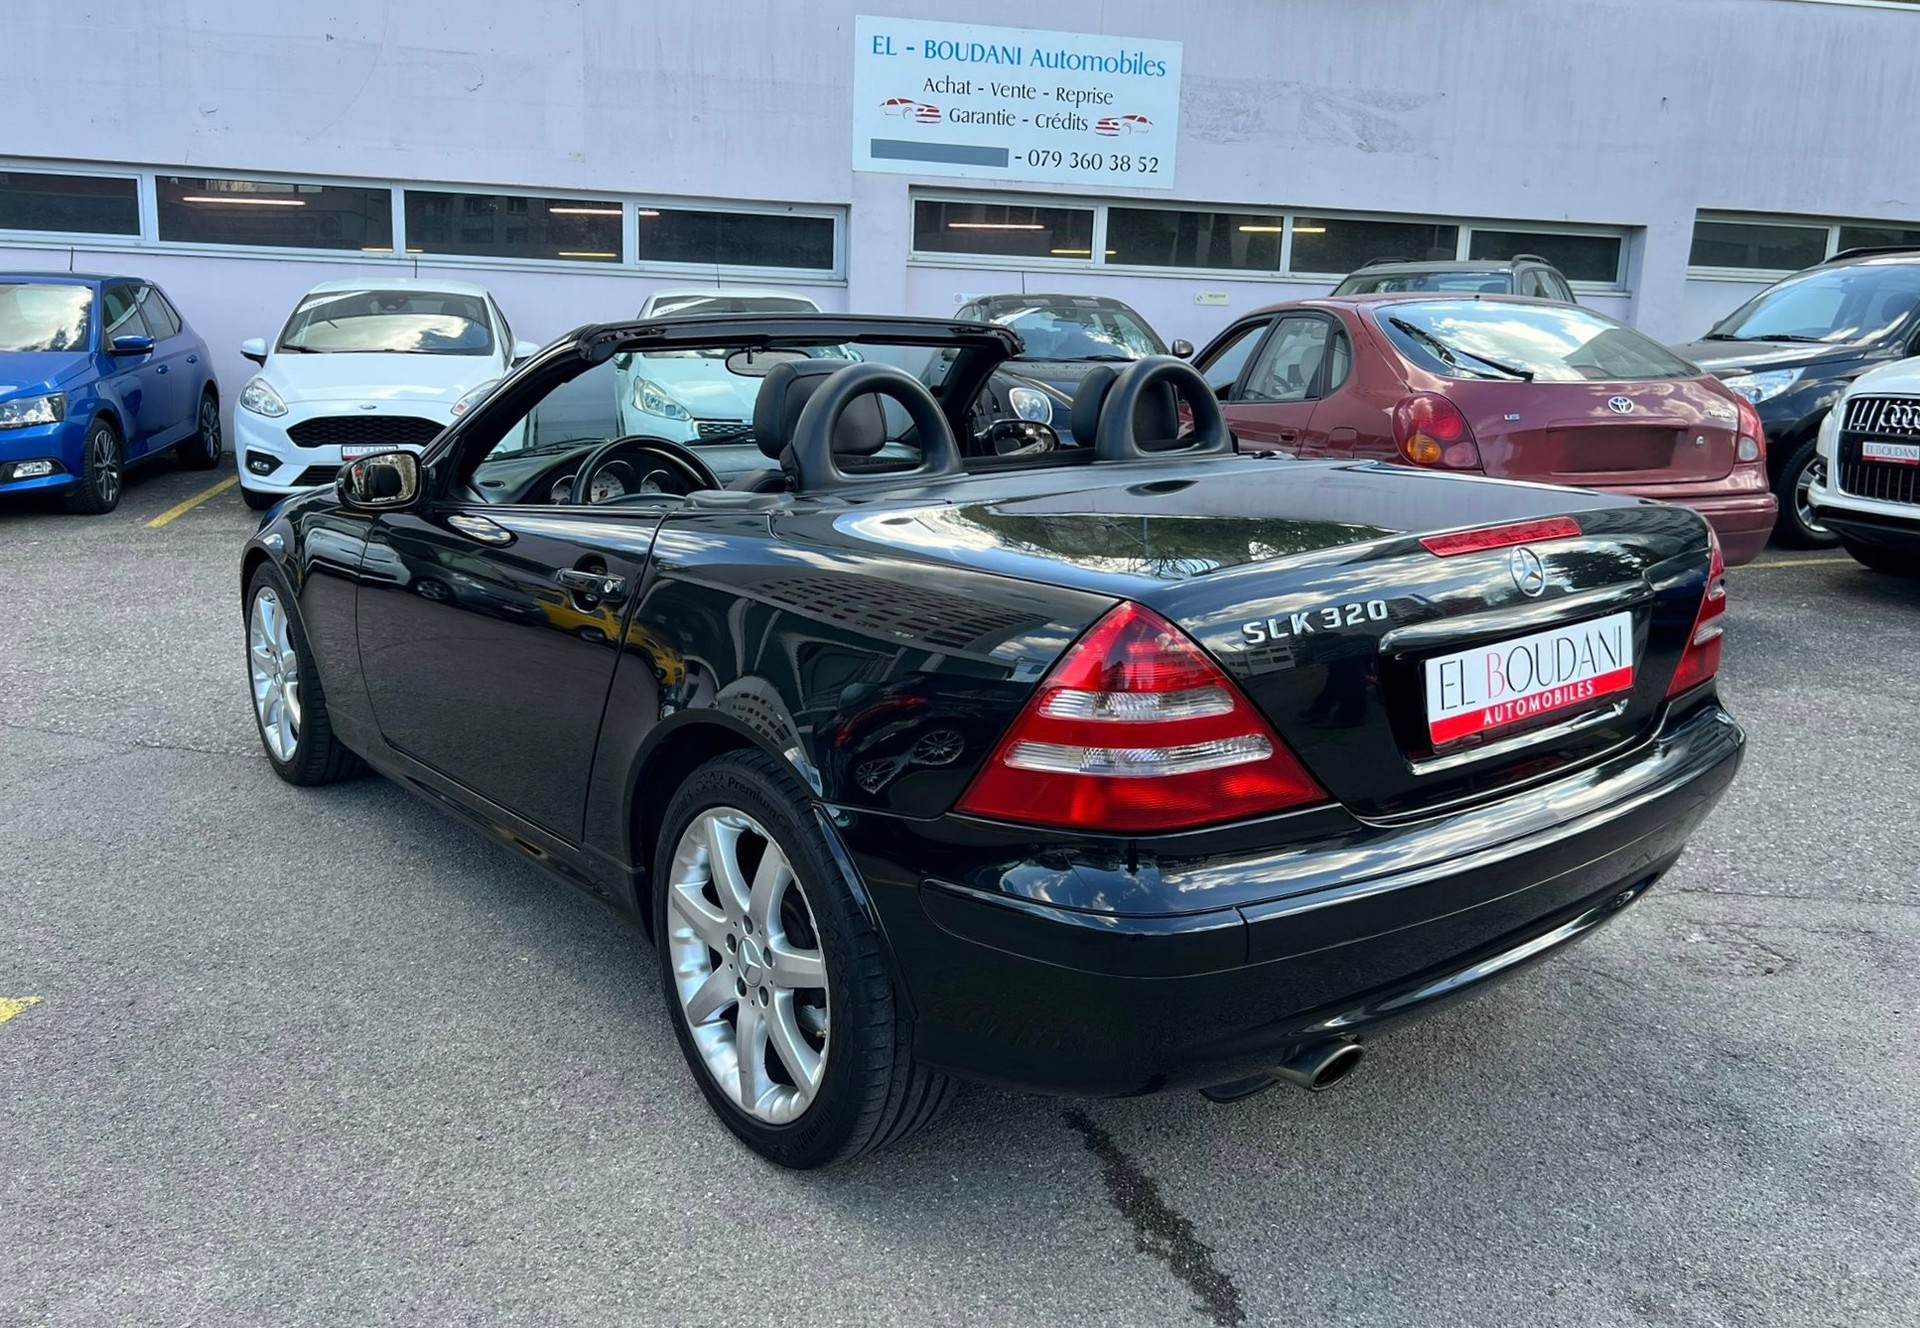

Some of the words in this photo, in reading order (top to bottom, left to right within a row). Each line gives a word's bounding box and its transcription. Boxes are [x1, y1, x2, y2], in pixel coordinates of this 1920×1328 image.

[873, 35, 897, 56] EL
[924, 39, 1021, 66] BOUDANI
[1030, 48, 1166, 77] Automobiles
[923, 75, 972, 95] Achat
[991, 82, 1037, 100] Vente
[1056, 87, 1114, 108] Reprise
[949, 107, 1016, 127] Garantie
[1035, 112, 1089, 132] Crédits
[1028, 149, 1063, 168] 079
[1069, 152, 1103, 171] 360
[1109, 154, 1131, 172] 38
[1138, 156, 1159, 173] 52
[1242, 610, 1316, 645] SLK
[1320, 599, 1388, 630] 320
[1440, 659, 1476, 711] EL
[1486, 625, 1622, 699] BOUDANI
[1483, 680, 1593, 726] AUTOMOBILES
